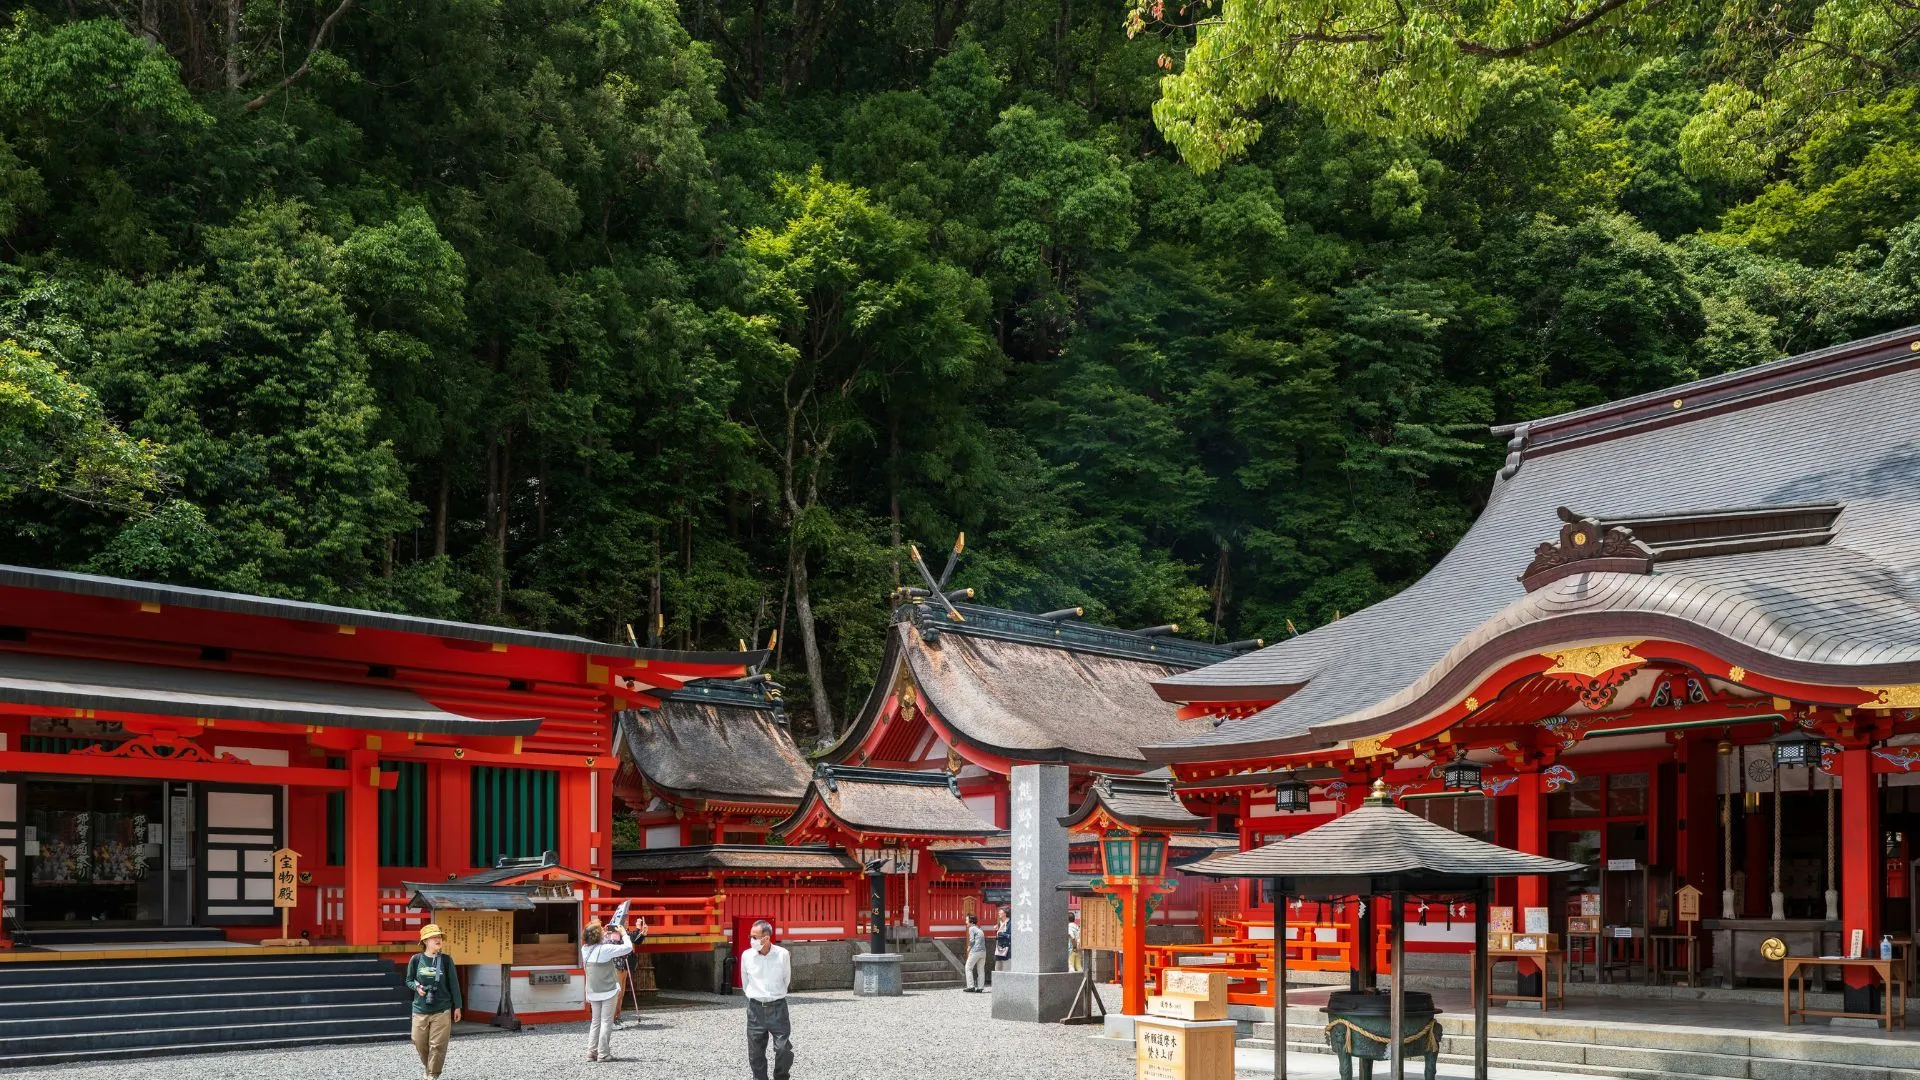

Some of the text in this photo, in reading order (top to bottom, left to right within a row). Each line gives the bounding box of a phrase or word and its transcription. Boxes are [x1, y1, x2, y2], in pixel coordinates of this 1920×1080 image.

[279, 855, 294, 901] 宝物殿
[1017, 781, 1033, 933] 熊野那智大社
